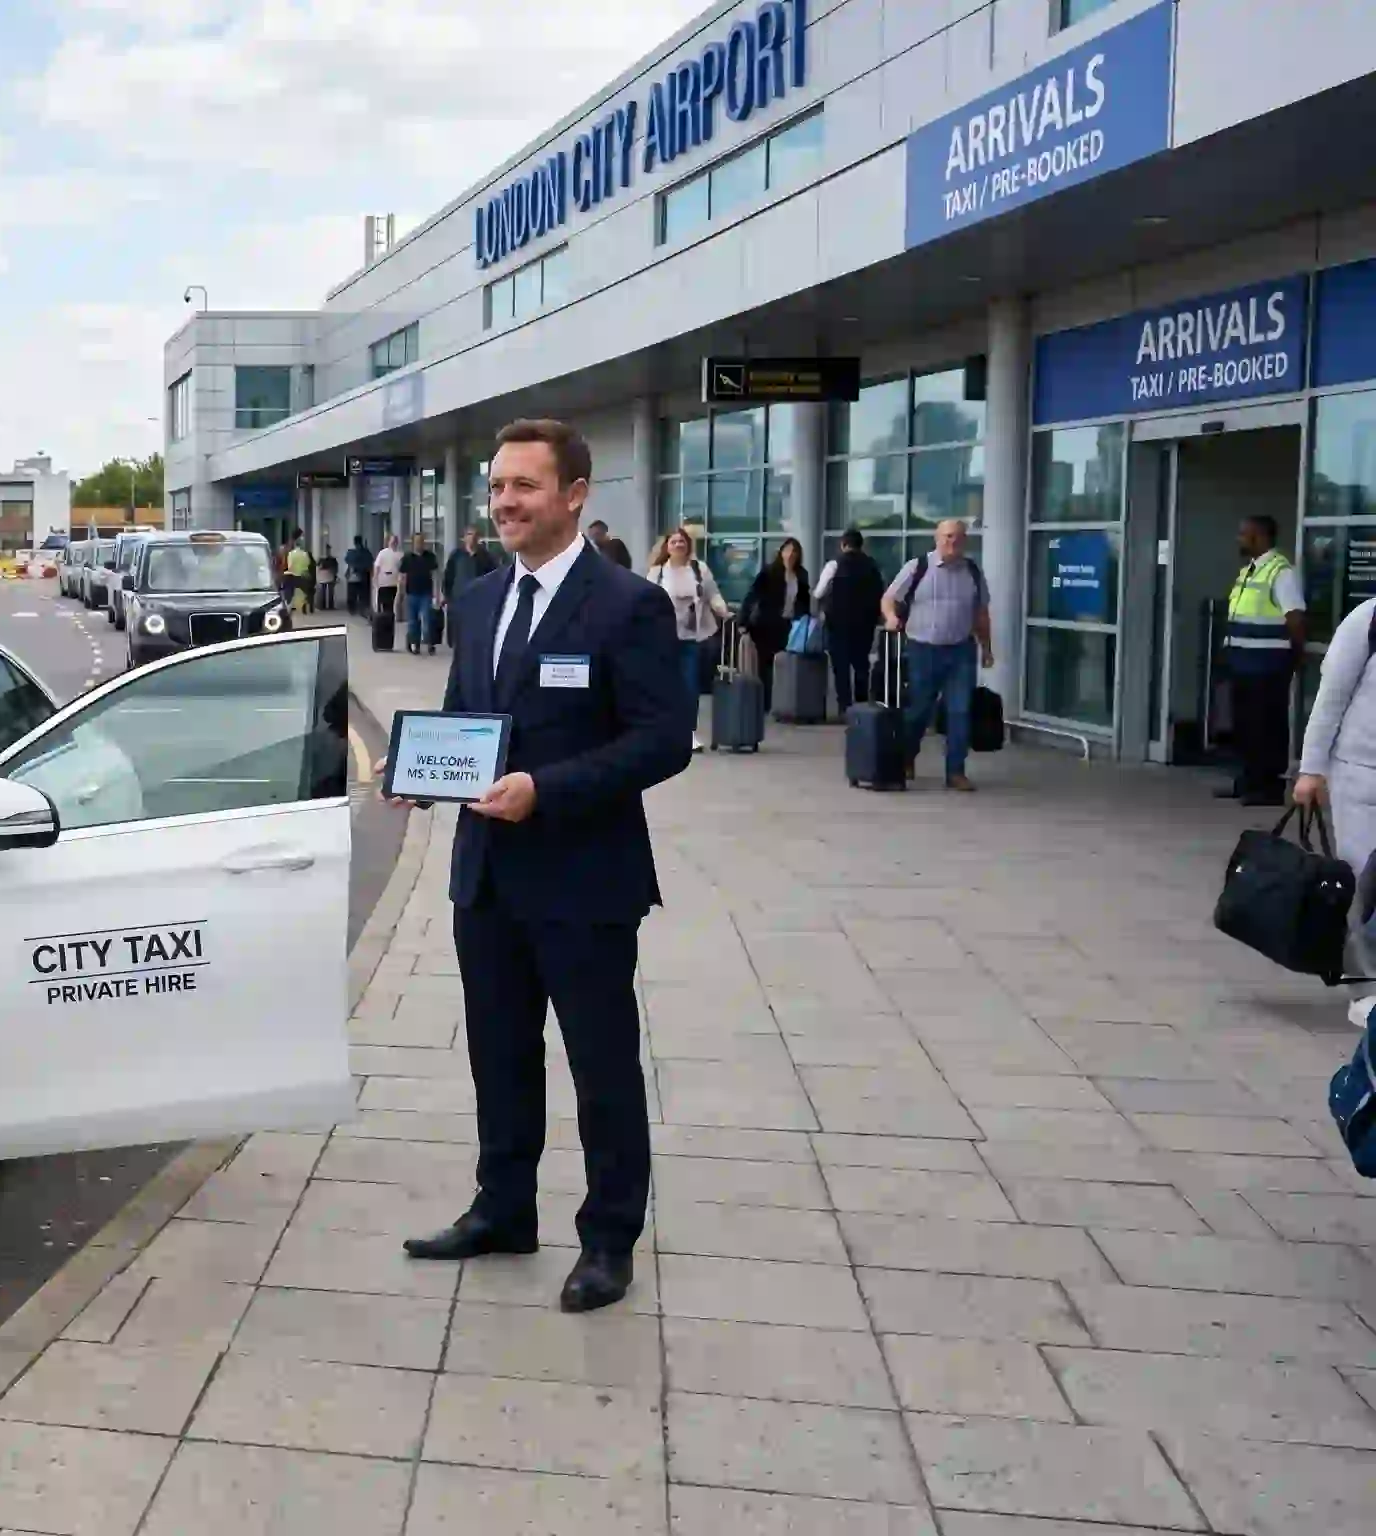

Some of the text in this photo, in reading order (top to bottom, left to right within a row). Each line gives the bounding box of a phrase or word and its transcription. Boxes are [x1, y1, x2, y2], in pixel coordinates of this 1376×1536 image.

[475, 0, 807, 270] LONDON CITY AIRPORT
[945, 53, 1106, 181] ARRIVALS
[942, 129, 1104, 221] TAXI / PRE-BOOKED
[1135, 291, 1286, 365] ARRIVALS
[1130, 352, 1289, 401] TAXI / PRE-BOOKED
[443, 770, 480, 782] SMITH
[32, 929, 202, 973] CITY TAXI
[47, 973, 197, 1004] PRIVATE HIRE
